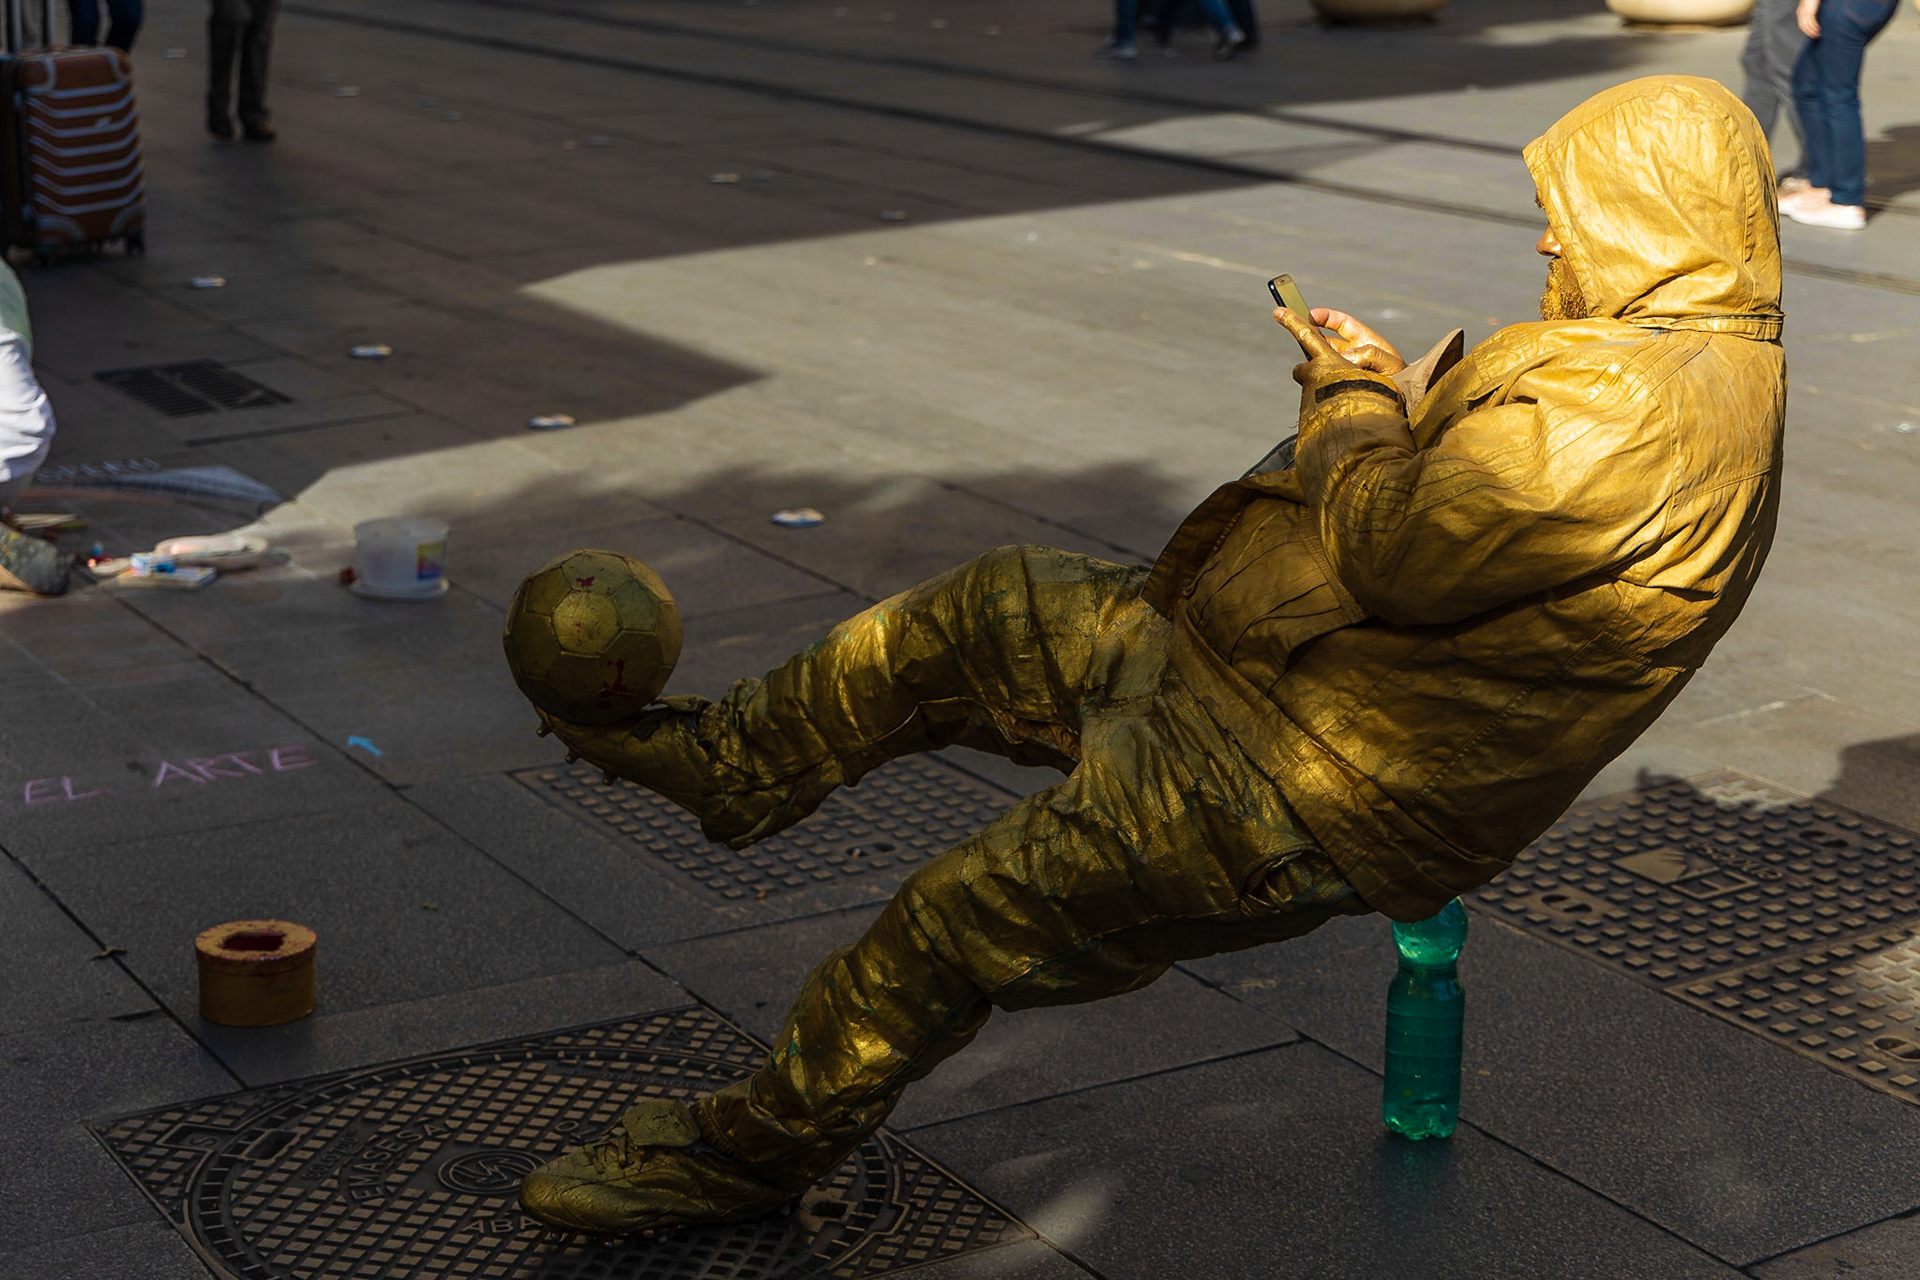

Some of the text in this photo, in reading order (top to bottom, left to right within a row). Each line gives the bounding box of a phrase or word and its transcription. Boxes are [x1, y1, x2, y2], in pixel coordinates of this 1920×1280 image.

[23, 745, 317, 803] EL ARTE
[349, 1123, 448, 1200] EMASESA
